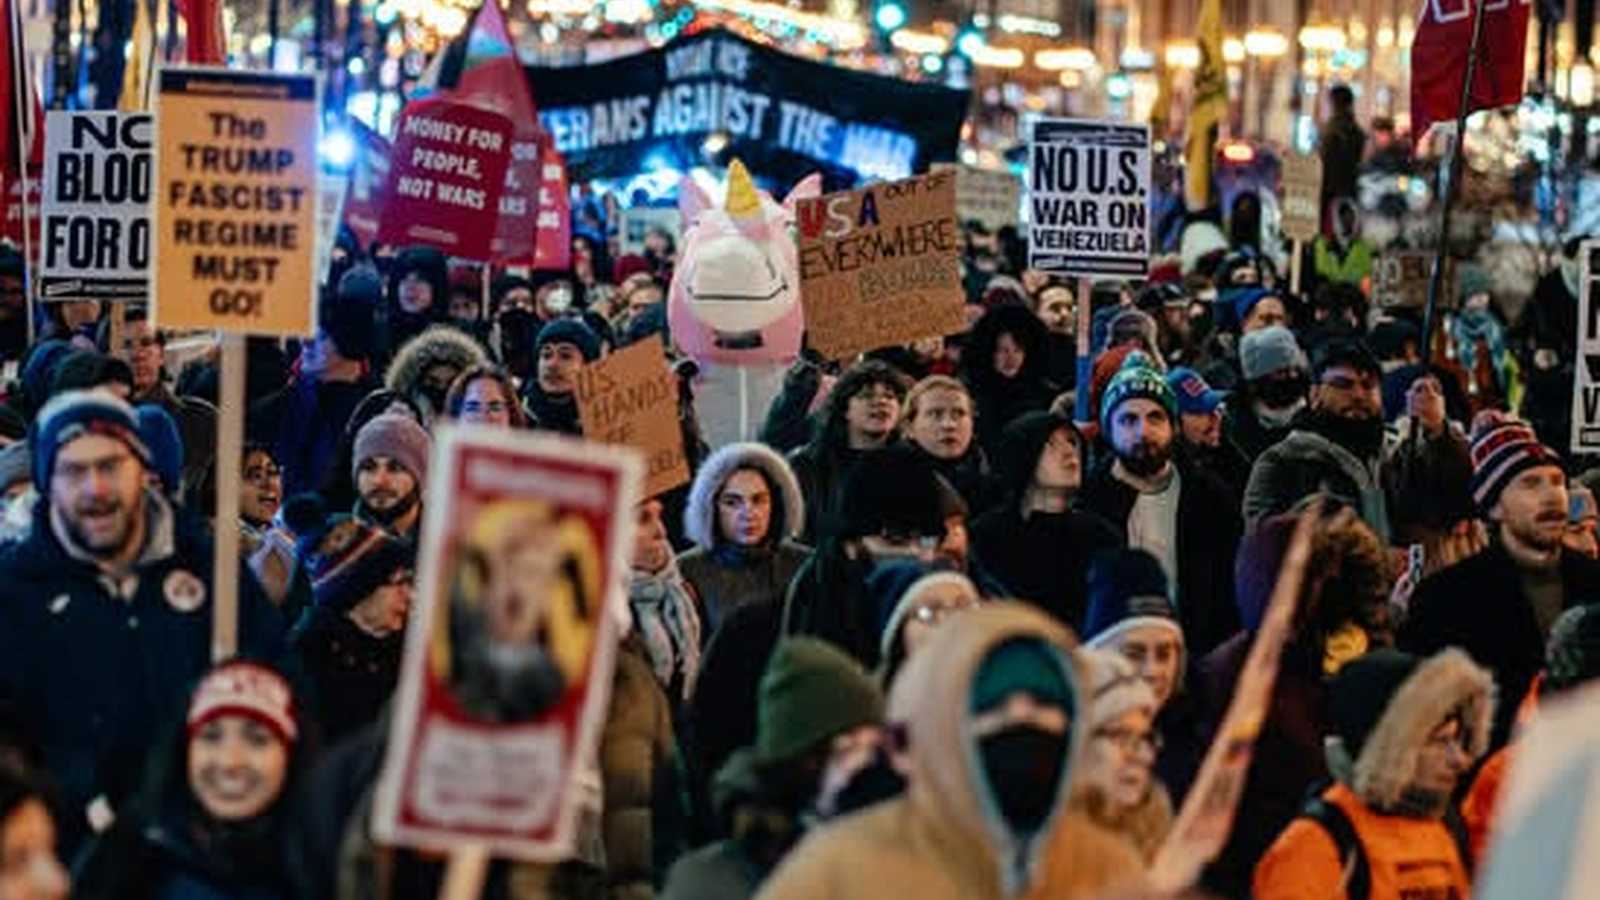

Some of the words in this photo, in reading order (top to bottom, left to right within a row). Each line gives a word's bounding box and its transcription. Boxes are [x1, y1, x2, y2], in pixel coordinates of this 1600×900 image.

[208, 112, 266, 140] The
[403, 116, 467, 145] MONEY
[467, 126, 504, 152] FOR
[778, 100, 839, 164] THE
[181, 144, 295, 174] TRUMP
[1033, 146, 1078, 192] NO
[1087, 148, 1146, 196] U.S.
[56, 153, 152, 204] BLOO
[397, 177, 434, 199] NOT
[437, 182, 487, 210] WARS
[168, 181, 304, 212] FASCIST
[1033, 198, 1098, 227] WAR
[1108, 201, 1146, 229] ON
[46, 215, 120, 270] FOR
[174, 218, 298, 250] REGIME
[1033, 228, 1147, 253] VENEZUELA
[192, 255, 279, 286] MUST
[208, 288, 264, 318] GO!
